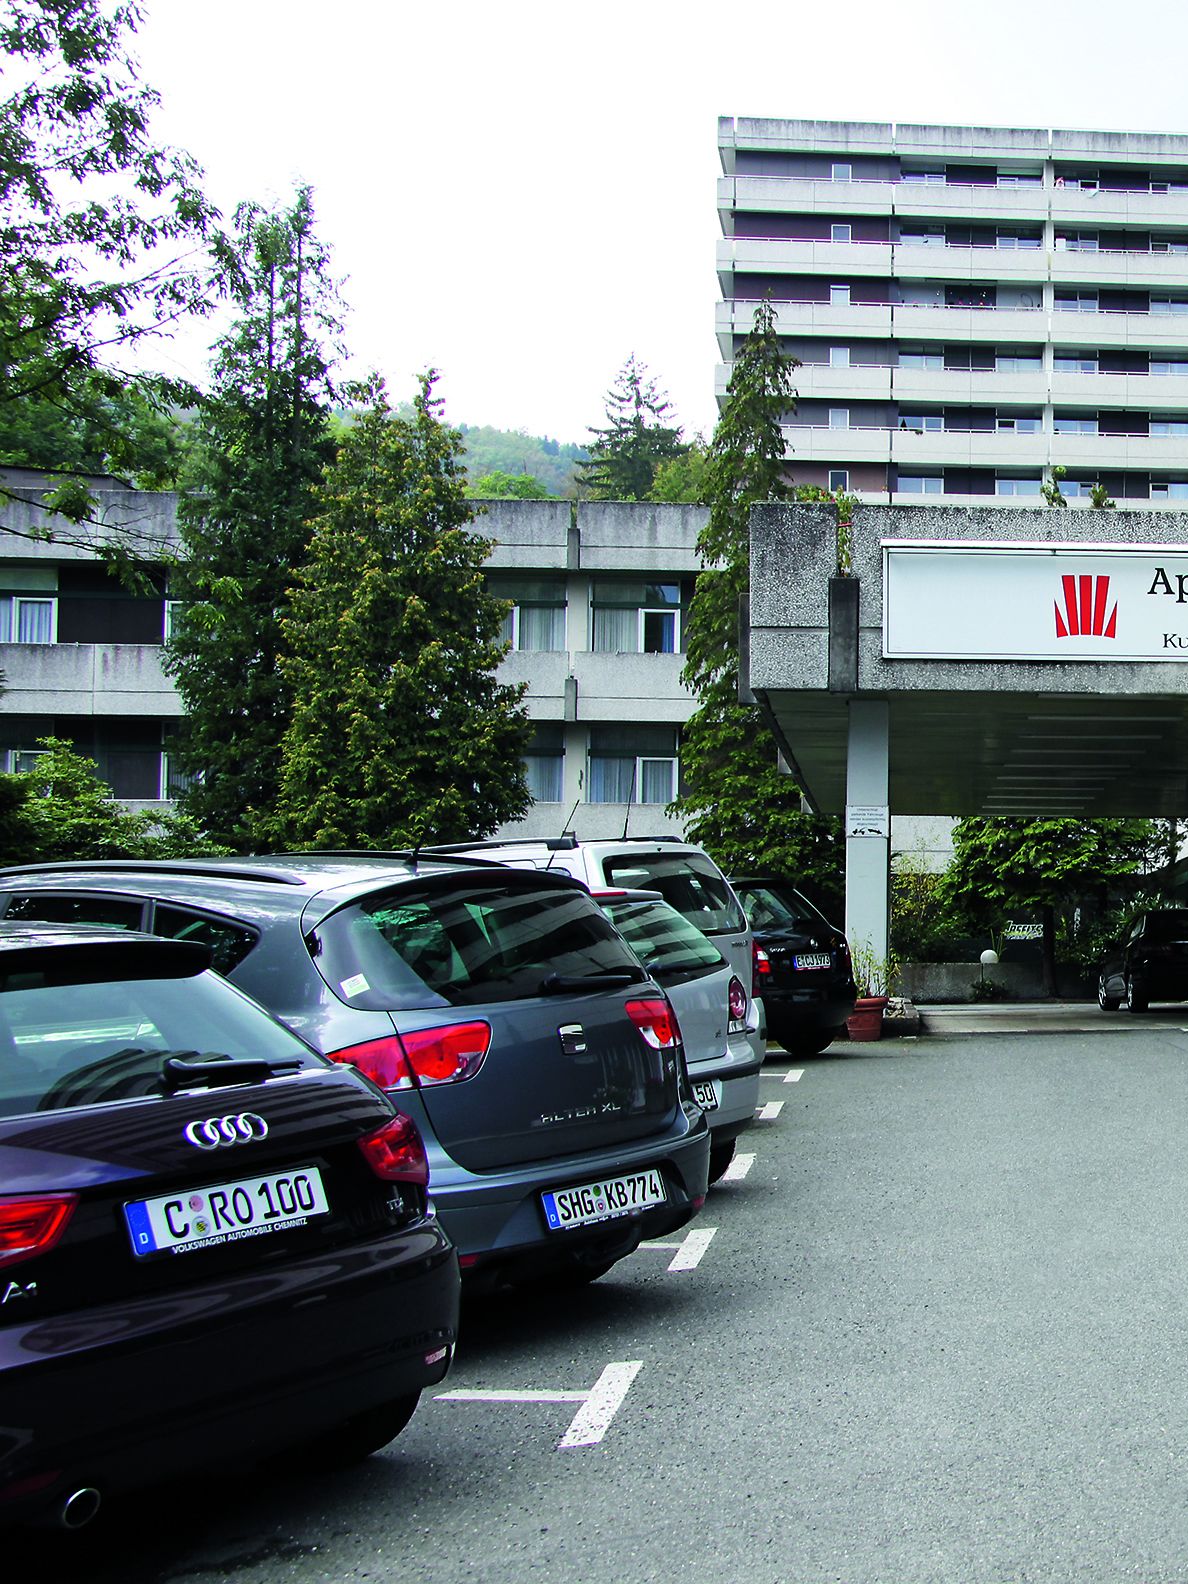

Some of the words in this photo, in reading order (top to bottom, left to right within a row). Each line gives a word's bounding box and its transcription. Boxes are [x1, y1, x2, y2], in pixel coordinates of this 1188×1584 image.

[139, 1232, 149, 1244] D
[164, 1200, 190, 1238] C
[208, 1187, 254, 1230] RO
[258, 1175, 315, 1219] 100
[558, 1188, 596, 1221] SHG
[172, 1235, 226, 1254] VOLKSWAGEN
[227, 1224, 272, 1242] AUTOMOBILE
[273, 1217, 308, 1232] CHEMNITZ
